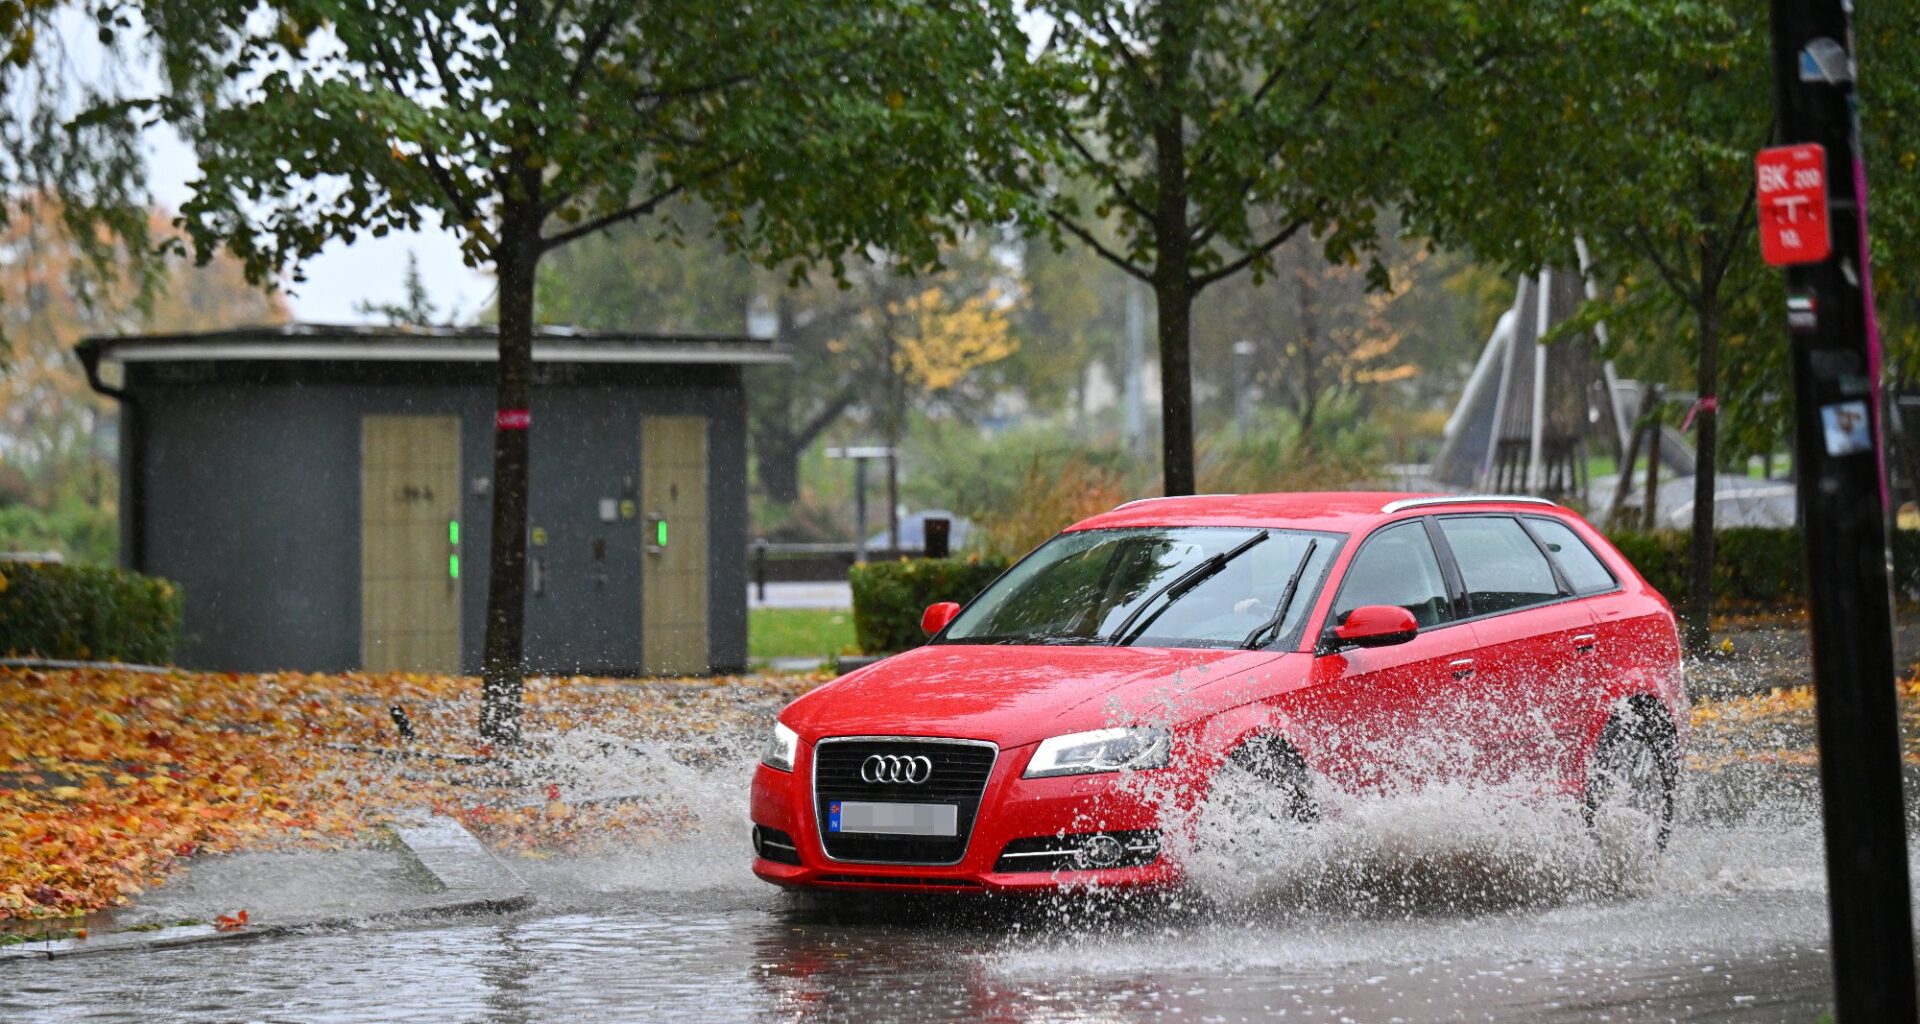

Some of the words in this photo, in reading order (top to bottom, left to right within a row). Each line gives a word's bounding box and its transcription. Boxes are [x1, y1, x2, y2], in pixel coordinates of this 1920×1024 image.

[1758, 163, 1790, 193] BK
[1793, 167, 1822, 190] 200
[831, 820, 838, 828] N
